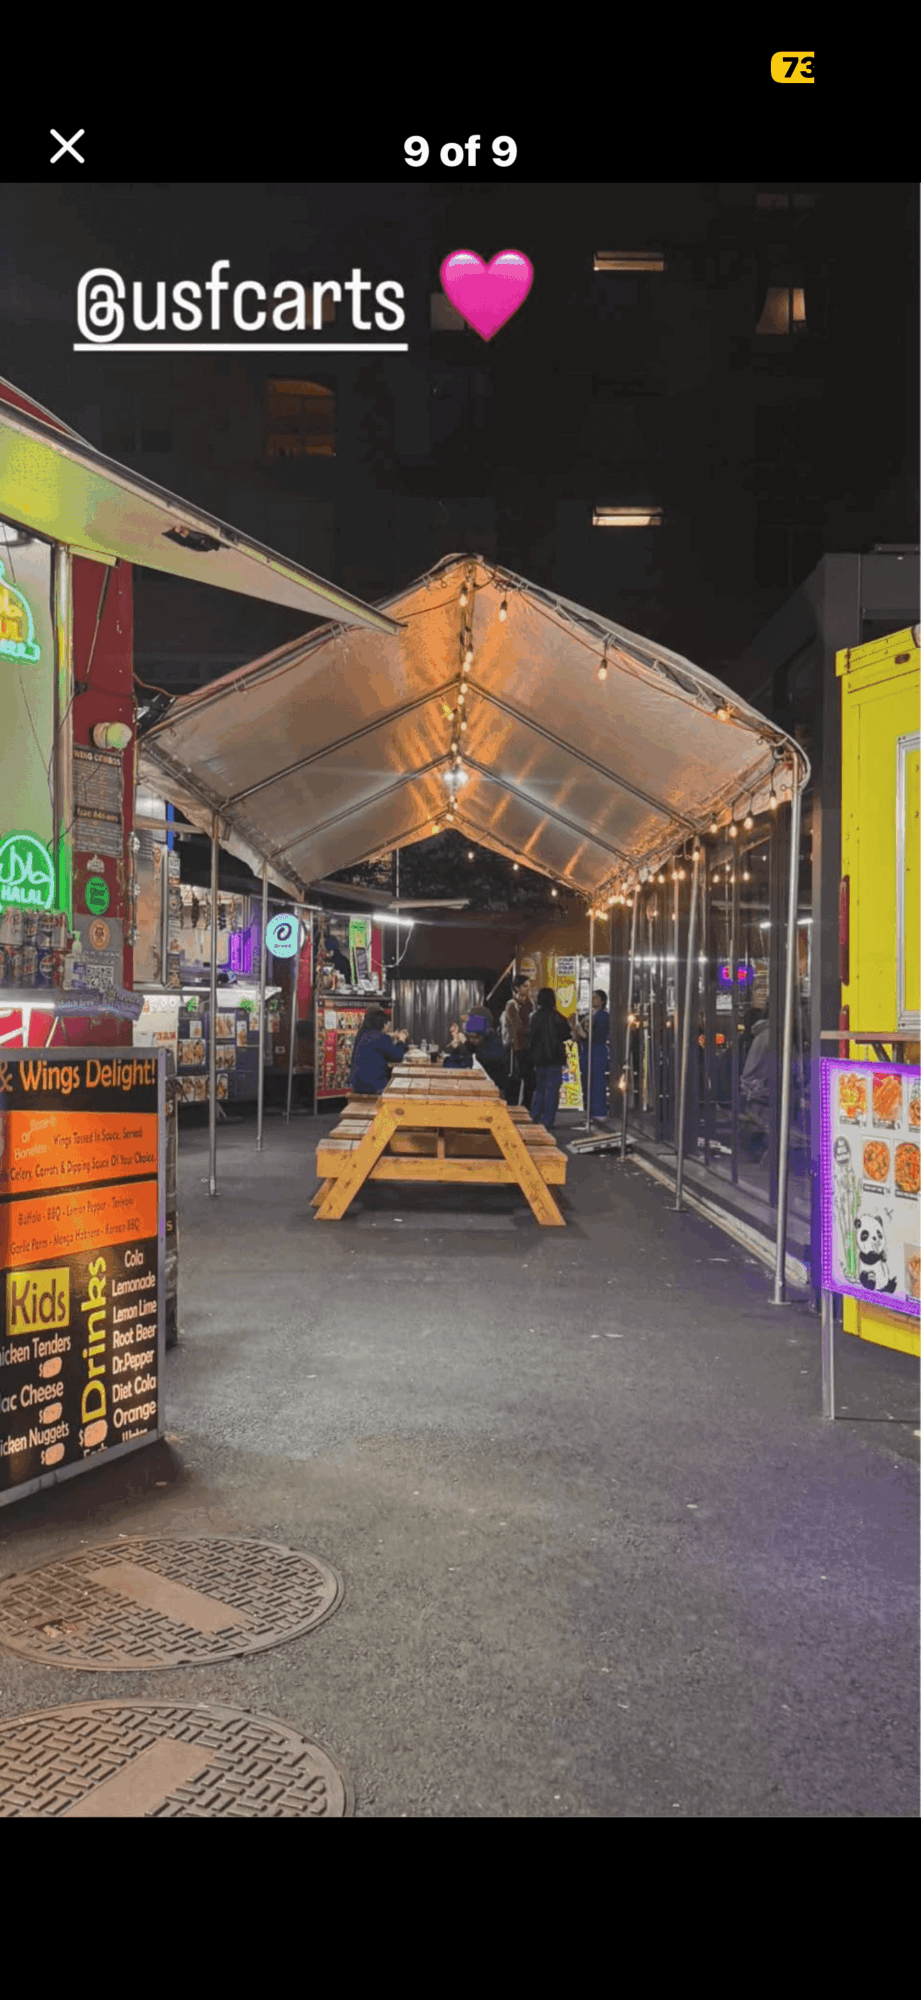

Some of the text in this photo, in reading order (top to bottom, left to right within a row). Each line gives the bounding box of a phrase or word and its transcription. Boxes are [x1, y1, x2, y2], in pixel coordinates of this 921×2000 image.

[1, 883, 44, 906] HALAL
[19, 1060, 80, 1095] Wings
[86, 1059, 156, 1091] Delight!
[124, 1250, 144, 1268] Cola
[112, 1271, 156, 1297] Lemonade
[11, 1278, 66, 1325] Kids
[112, 1299, 157, 1324] Lemon Lime
[32, 1332, 71, 1359] Tenders
[81, 1256, 107, 1424] Drinks
[112, 1324, 157, 1349] Root Beer
[0, 1394, 17, 1414] ac
[20, 1381, 64, 1407] Cheese
[112, 1374, 156, 1403] Diet Cola
[113, 1401, 157, 1428] Orange
[29, 1420, 70, 1448] Nuggets
